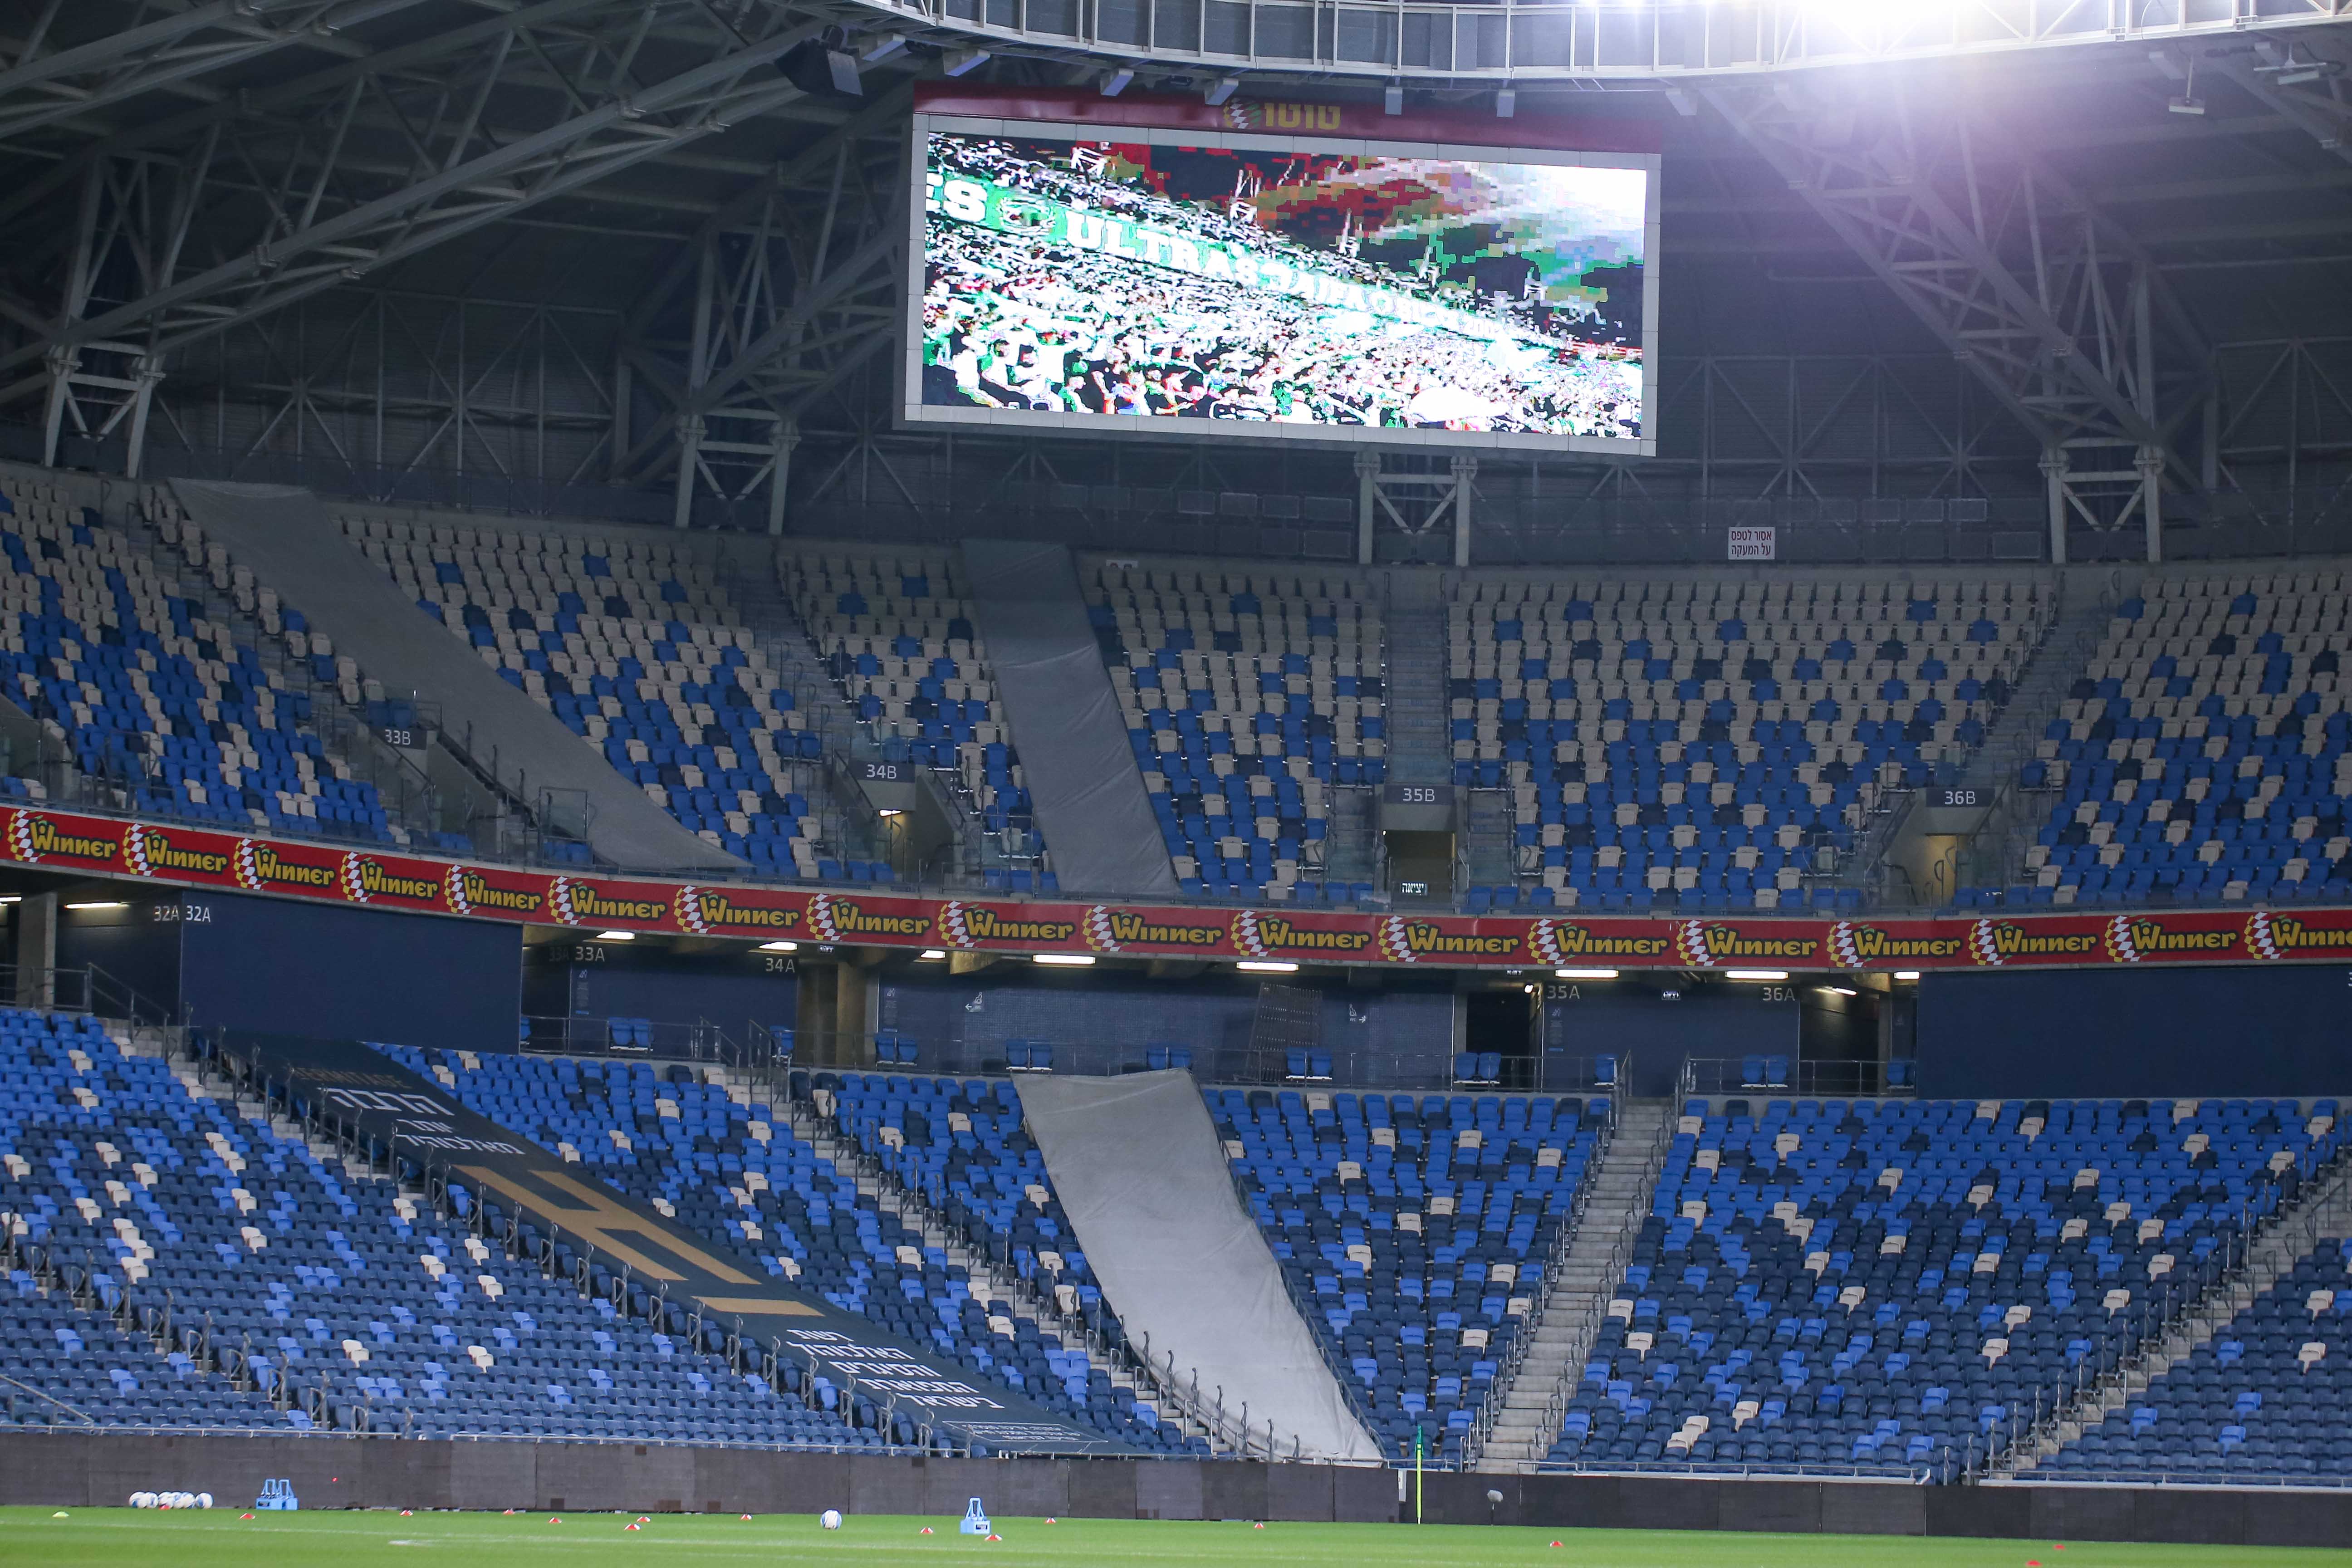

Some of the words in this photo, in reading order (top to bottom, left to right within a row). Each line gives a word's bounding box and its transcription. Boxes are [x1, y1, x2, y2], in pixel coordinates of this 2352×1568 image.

[1264, 103, 1341, 130] טוטו
[1066, 210, 1258, 285] ULTRAS
[1731, 529, 1752, 541] לטפס
[1754, 530, 1772, 541] אסור
[1731, 544, 1759, 558] המעקה
[1761, 542, 1771, 556] על
[385, 729, 411, 745] 33B
[866, 764, 897, 779] 34B
[1402, 788, 1435, 802] 35B
[1945, 791, 1975, 804] 36B
[1401, 882, 1425, 894] יציאה
[153, 905, 180, 922] 32A
[186, 905, 211, 922] 32A
[575, 946, 605, 962] 33A
[765, 957, 795, 973] 34A
[1547, 985, 1580, 1000] 35A
[1762, 987, 1795, 1001] 36A
[317, 1087, 455, 1116] הרבה
[396, 1119, 453, 1133] יותר
[395, 1133, 526, 1155] מאלכוהול
[786, 1329, 855, 1342] רשת
[785, 1341, 915, 1360] האלכוהול
[828, 1361, 942, 1377] והסיגרים
[858, 1377, 980, 1393] המפוארת
[896, 1392, 1005, 1409] בישראל
